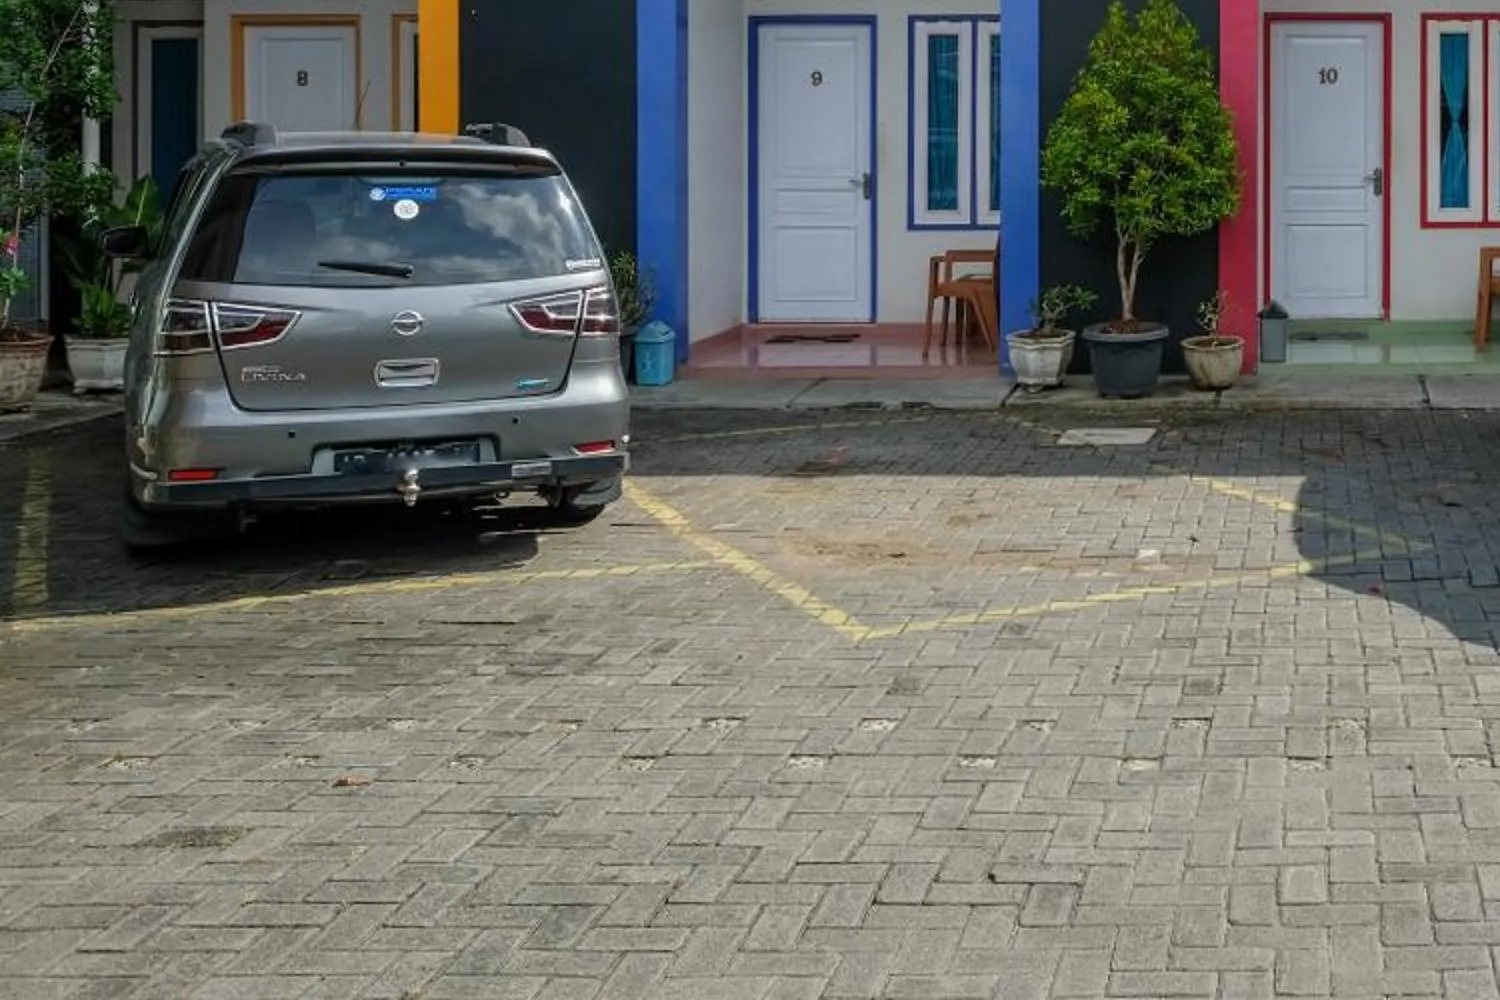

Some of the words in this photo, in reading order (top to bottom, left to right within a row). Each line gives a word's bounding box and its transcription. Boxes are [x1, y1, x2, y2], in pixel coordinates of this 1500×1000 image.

[297, 70, 309, 87] 8
[811, 70, 823, 87] 9
[1318, 66, 1339, 85] 10
